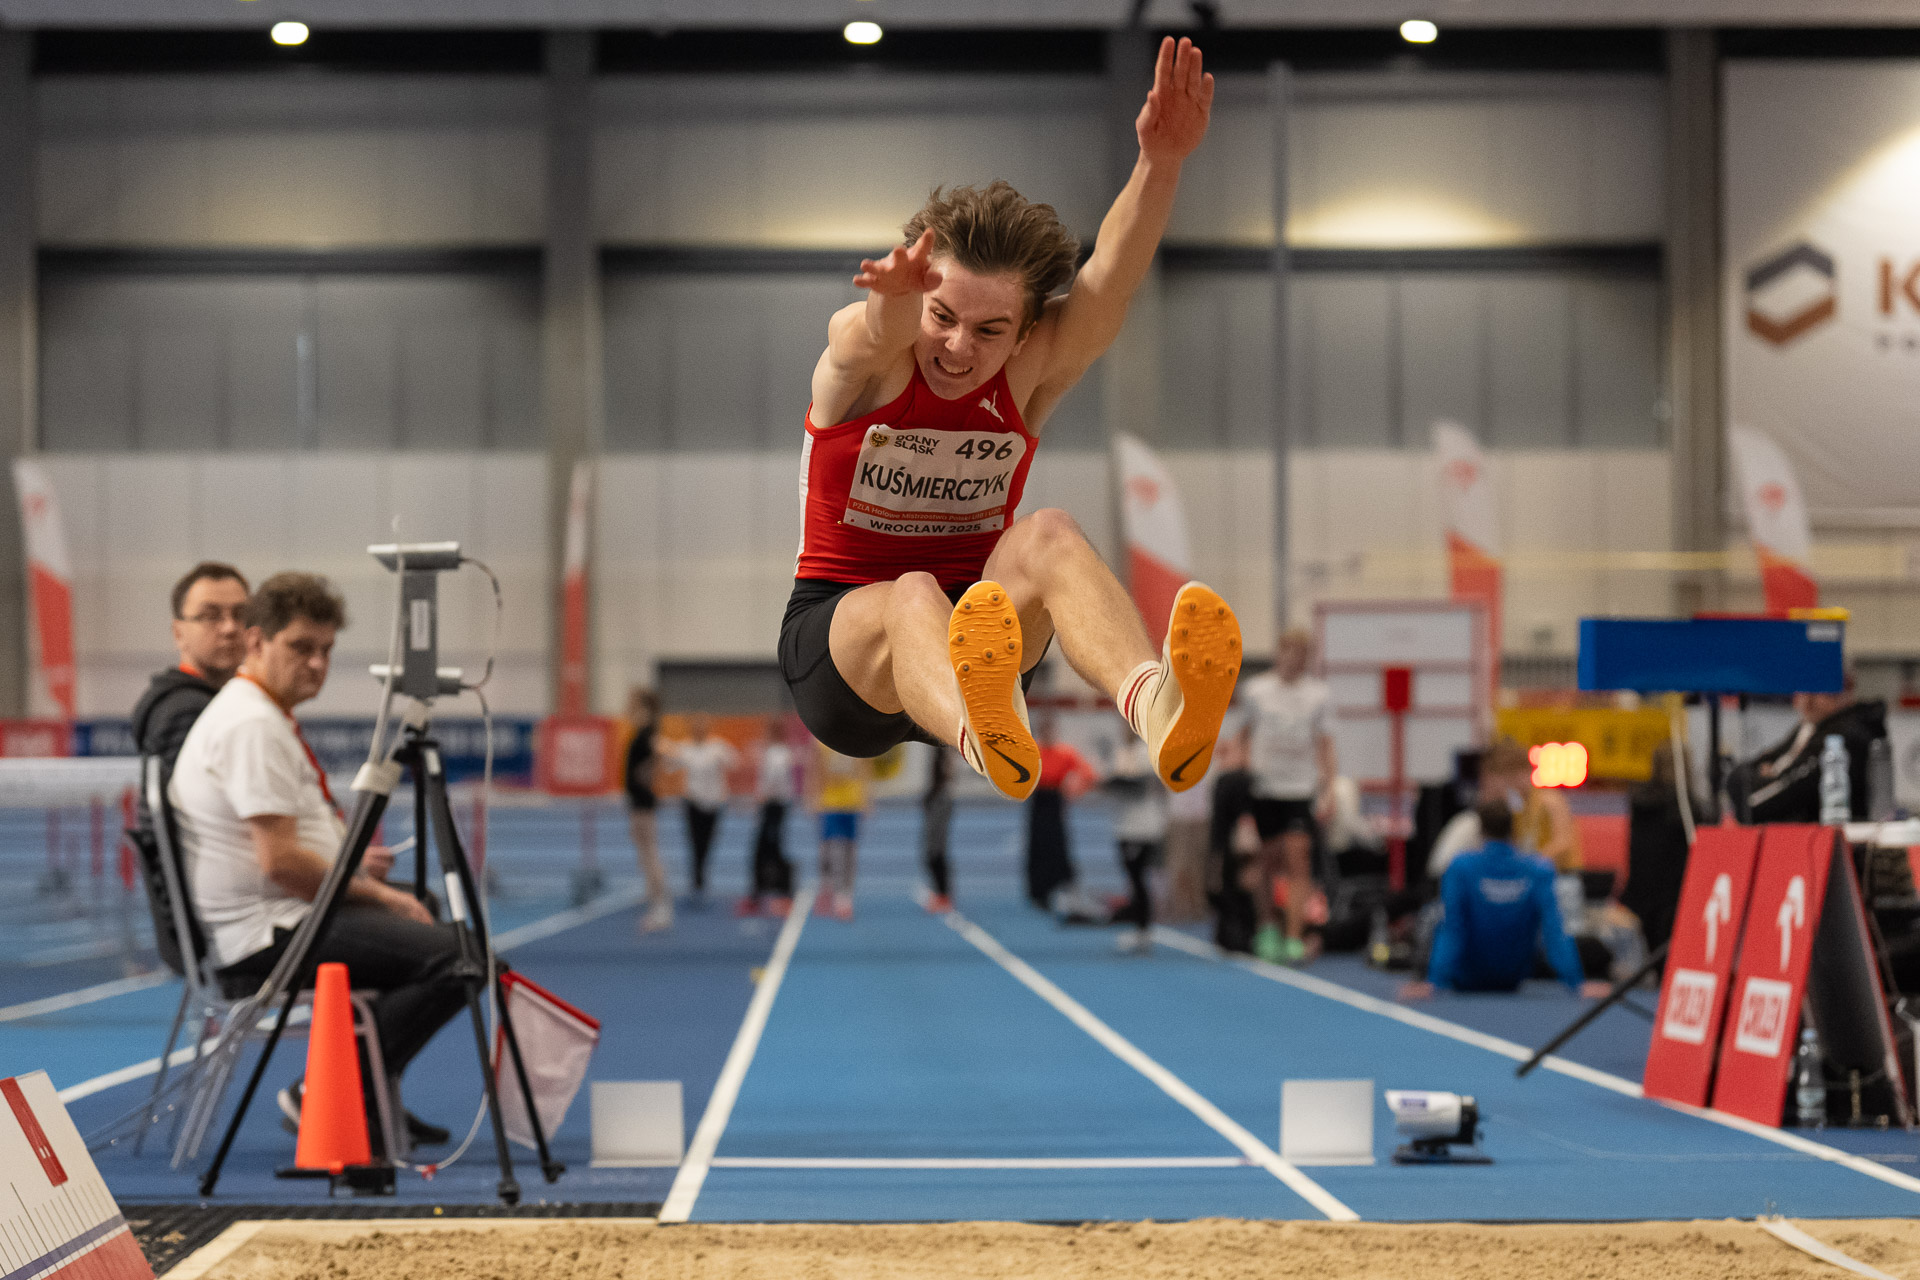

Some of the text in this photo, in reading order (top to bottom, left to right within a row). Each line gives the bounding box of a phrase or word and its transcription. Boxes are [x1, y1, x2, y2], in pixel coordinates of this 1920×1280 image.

[896, 434, 941, 447] DOLNY
[955, 438, 1013, 461] 496
[860, 462, 1010, 501] KUŚMIERCZYK
[852, 502, 870, 512] PZLA
[870, 519, 981, 533] WROCŁAW 2025
